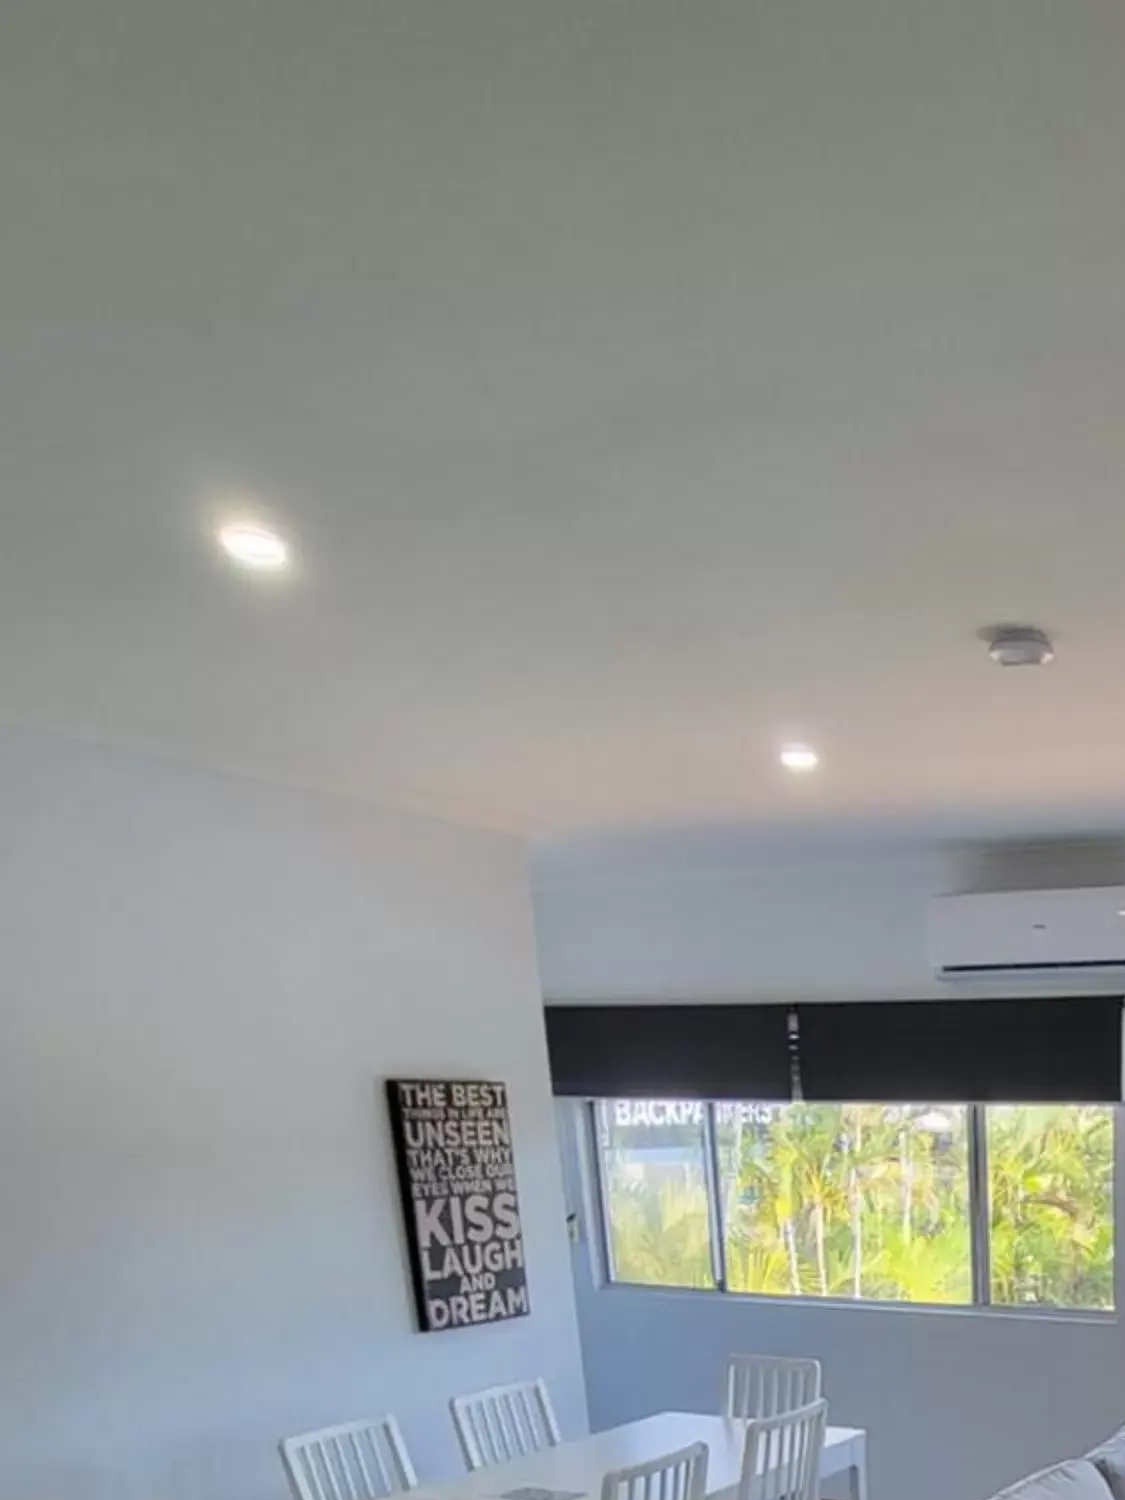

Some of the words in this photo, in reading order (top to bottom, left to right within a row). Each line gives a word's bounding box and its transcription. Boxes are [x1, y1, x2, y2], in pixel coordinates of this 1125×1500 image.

[400, 1083, 446, 1107] THE
[451, 1083, 503, 1107] BEST
[404, 1119, 510, 1148] UNSEEN
[406, 1148, 470, 1168] THAT'S
[472, 1146, 512, 1166] WHY
[438, 1165, 482, 1181] CLOSE
[414, 1193, 521, 1248] KISS
[421, 1240, 523, 1281] LAUGH
[459, 1274, 496, 1294] AND
[428, 1288, 528, 1329] DREAM
